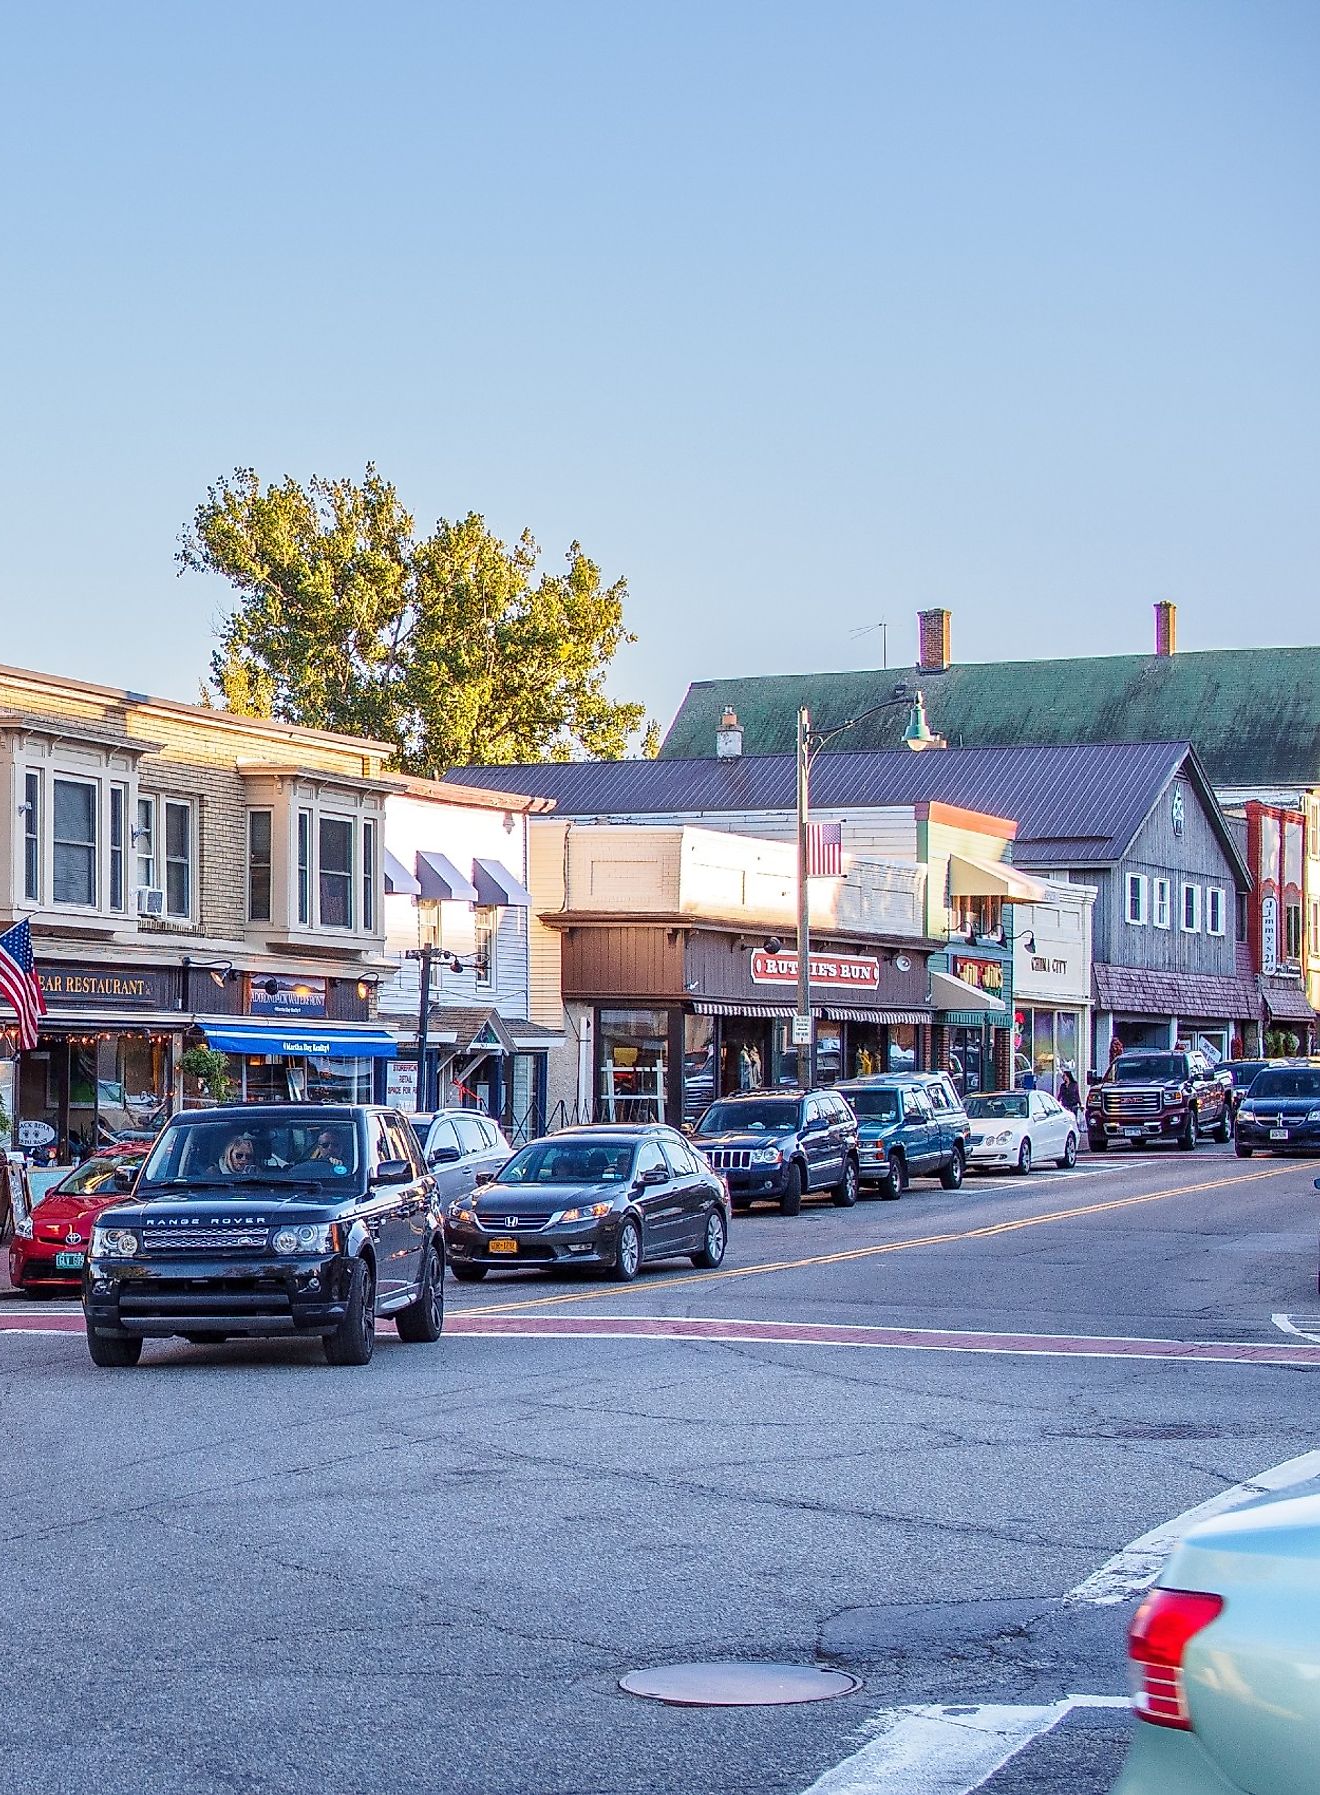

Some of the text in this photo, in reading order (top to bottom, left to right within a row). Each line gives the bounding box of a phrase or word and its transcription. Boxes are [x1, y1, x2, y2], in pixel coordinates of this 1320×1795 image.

[766, 960, 871, 979] RUTIE'S RUN
[1052, 958, 1068, 974] CITY
[38, 975, 145, 996] EAR RESTAURANT
[286, 1042, 303, 1051] Martha
[303, 1043, 312, 1052] Day
[388, 1086, 401, 1094] SPACE
[402, 1086, 411, 1094] FOR
[146, 1217, 266, 1226] RANGE ROVER
